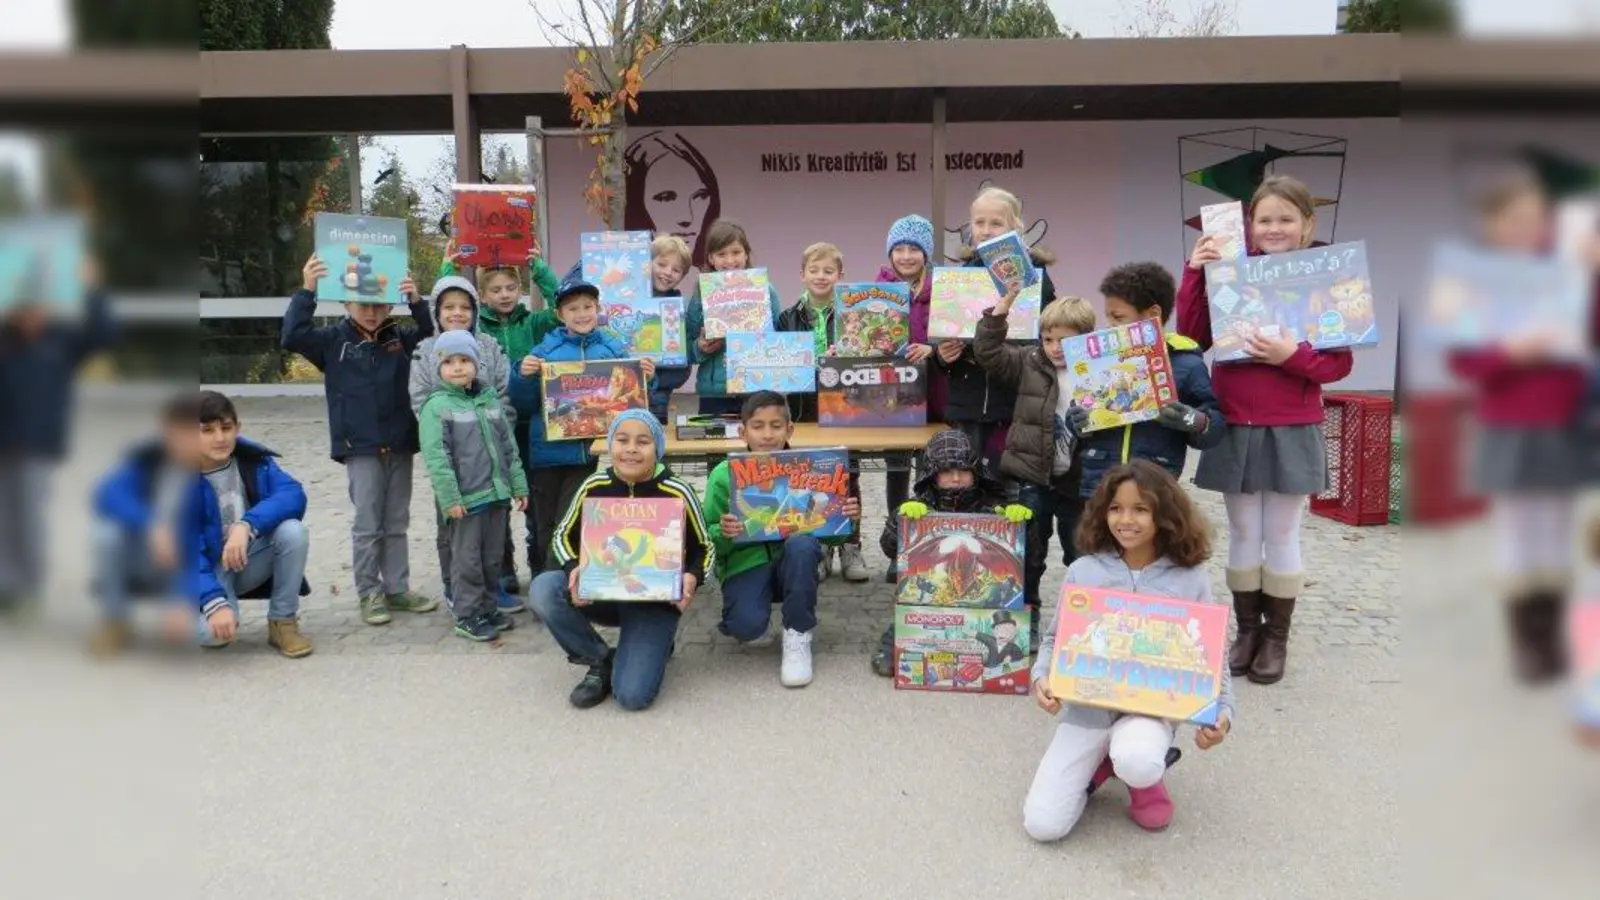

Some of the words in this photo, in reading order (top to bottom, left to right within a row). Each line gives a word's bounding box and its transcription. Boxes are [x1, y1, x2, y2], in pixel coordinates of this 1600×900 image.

[761, 152, 801, 172] Nikis
[930, 149, 1023, 171] nsteckend
[329, 227, 397, 245] dimension
[840, 365, 919, 387] CLUEDO
[610, 503, 657, 518] CATAN
[906, 612, 962, 625] MONOPOLY
